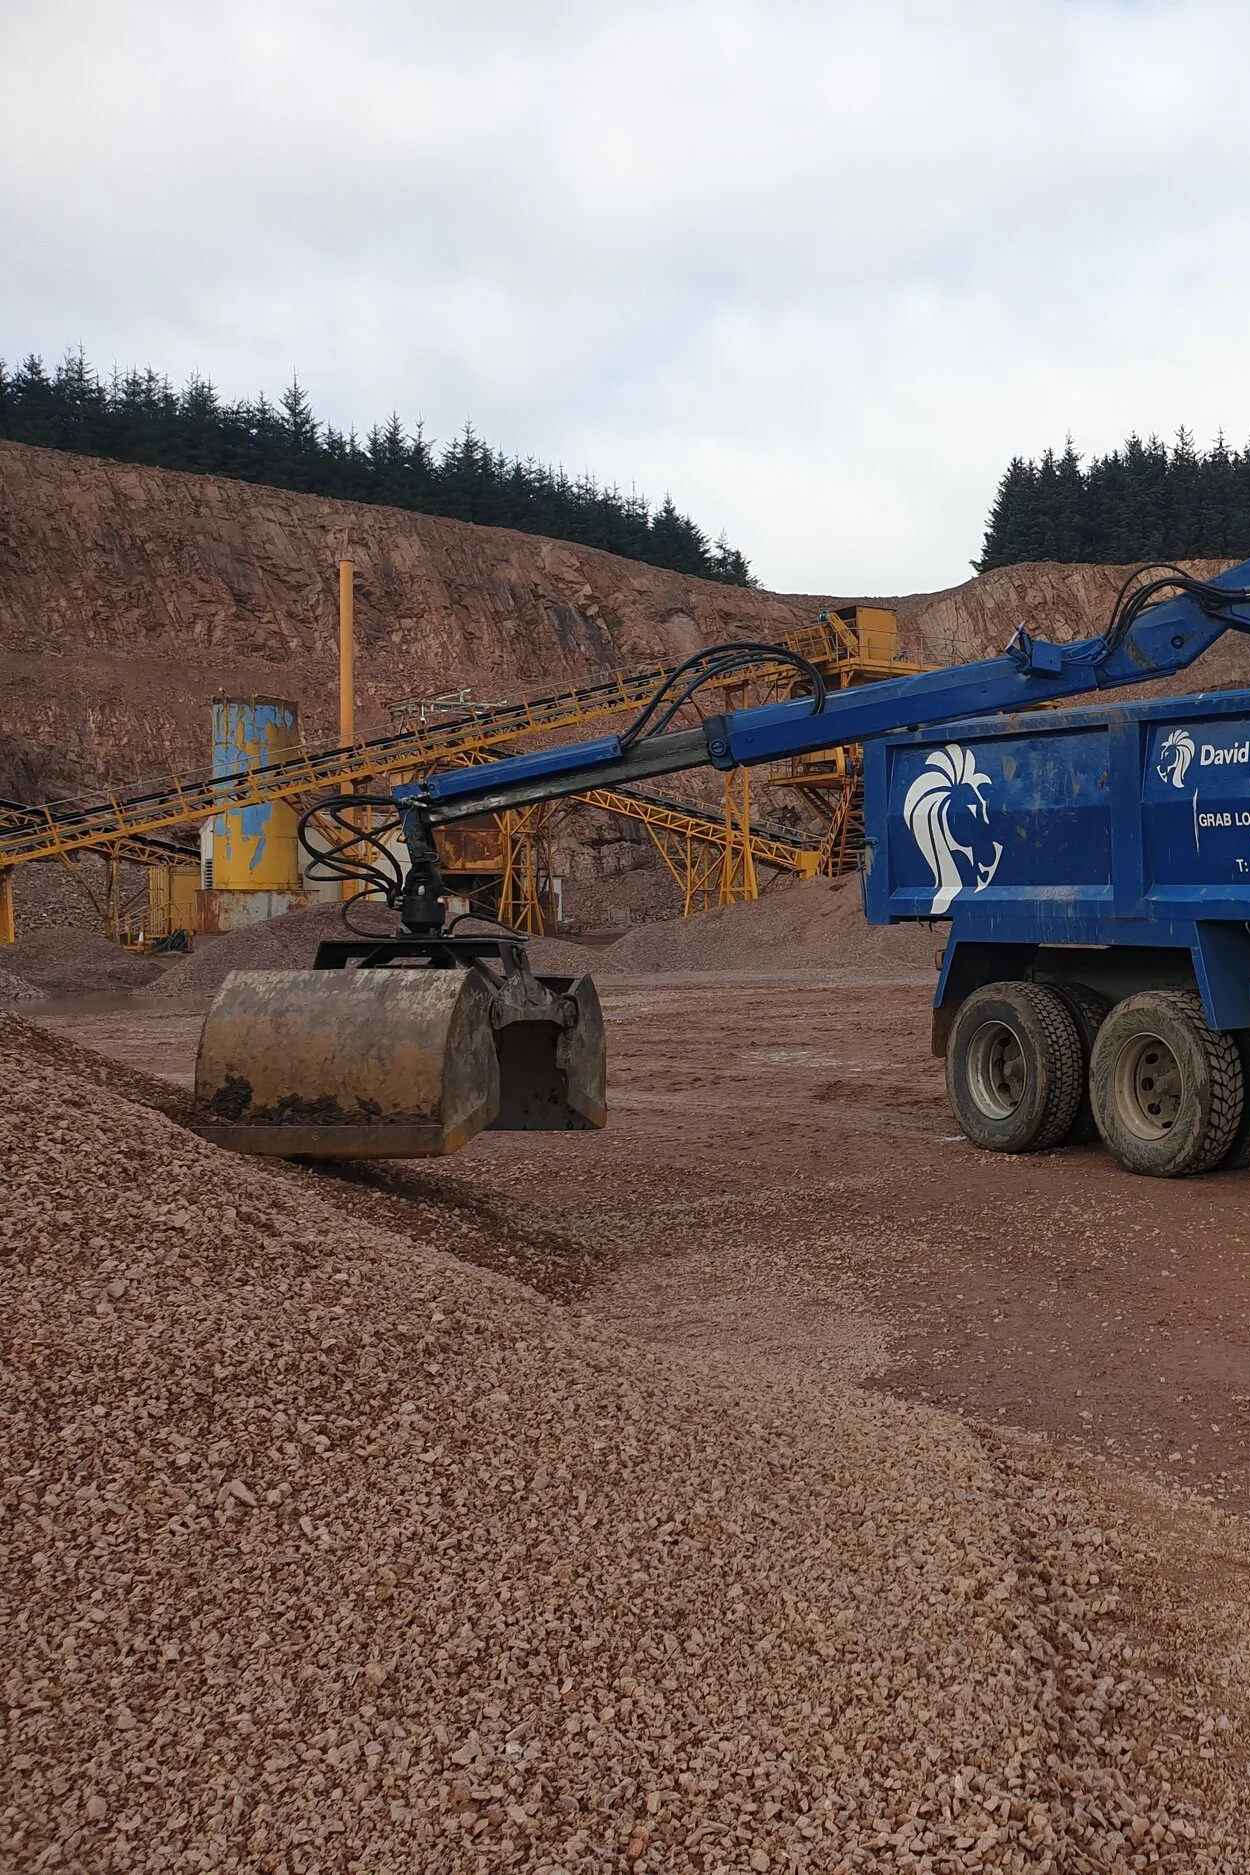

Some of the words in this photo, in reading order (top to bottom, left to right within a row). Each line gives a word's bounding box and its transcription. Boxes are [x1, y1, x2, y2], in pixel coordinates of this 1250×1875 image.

[1200, 741, 1249, 766] David
[1198, 811, 1232, 827] GRAB
[1236, 859, 1249, 873] T:
